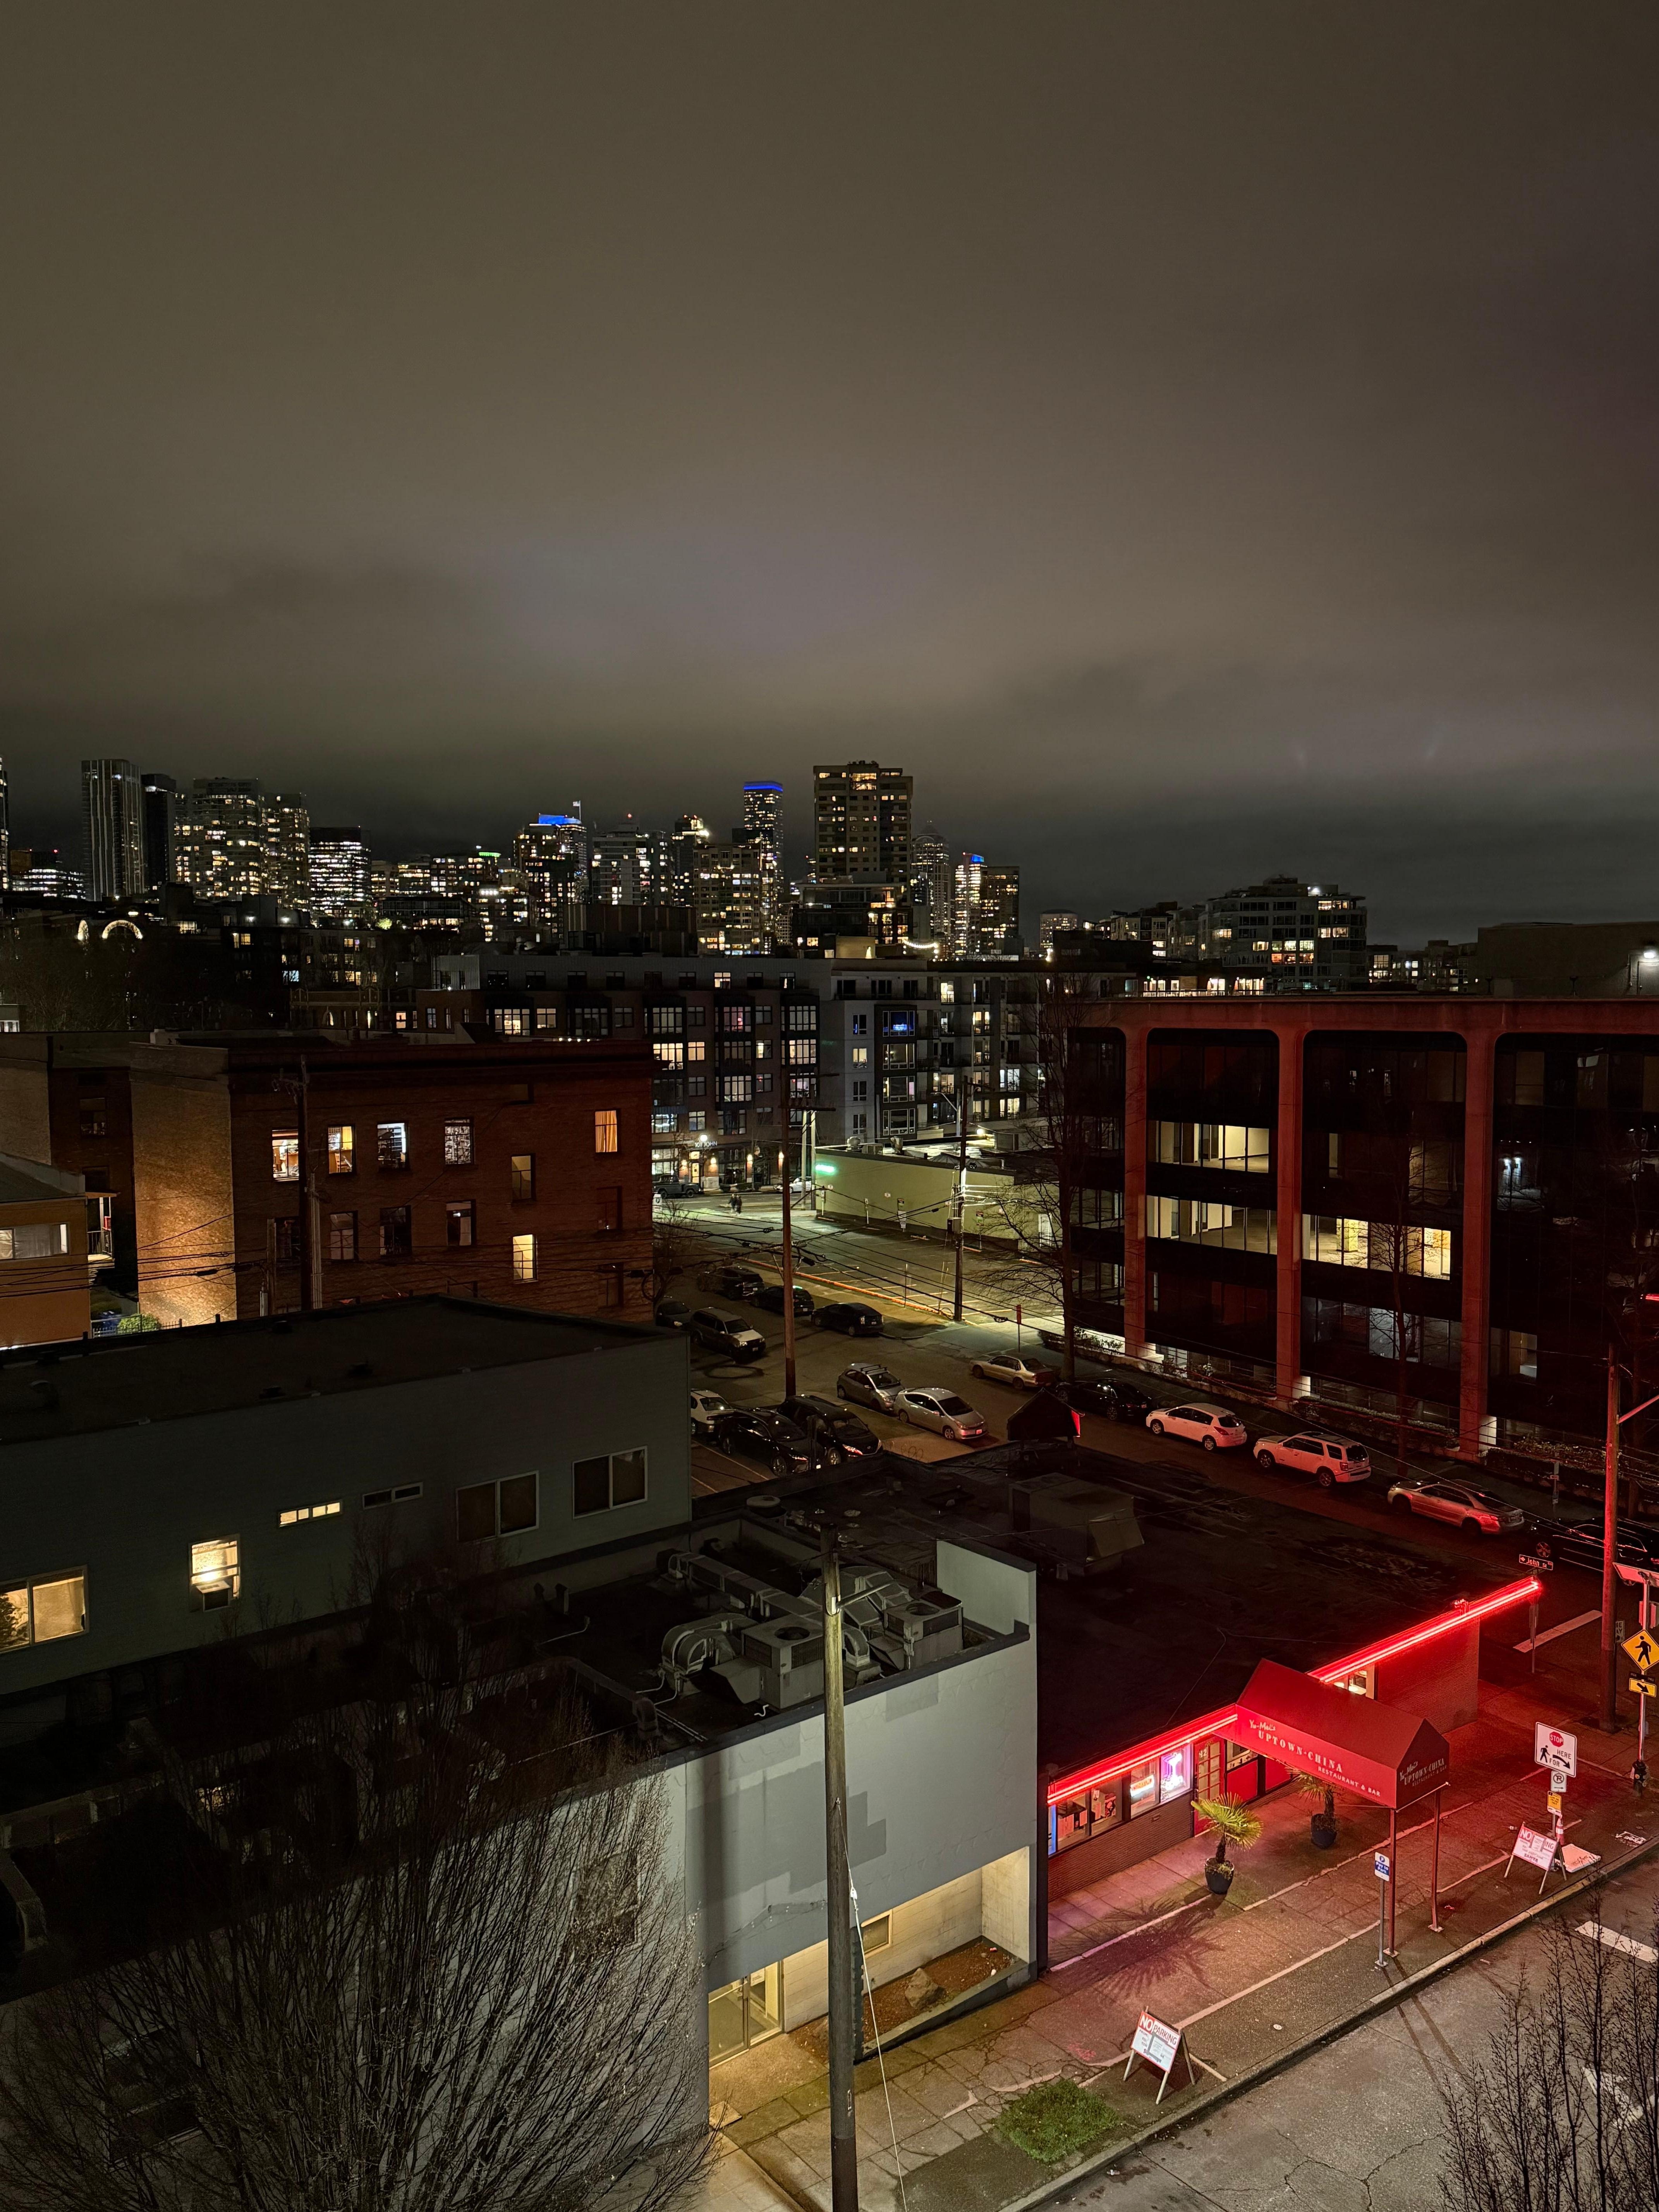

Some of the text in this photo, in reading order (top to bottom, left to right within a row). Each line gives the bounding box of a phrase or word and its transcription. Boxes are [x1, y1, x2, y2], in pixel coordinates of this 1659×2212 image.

[1526, 1558, 1539, 1567] John
[1550, 1735, 1563, 1744] STOP
[1557, 1749, 1571, 1760] HERE
[1549, 1759, 1560, 1767] FOR
[1318, 1766, 1359, 1787] RESTAURANT
[1368, 1787, 1380, 1797] BAR
[1520, 1828, 1532, 1841] NO
[1139, 2014, 1177, 2045] NO PARKING
